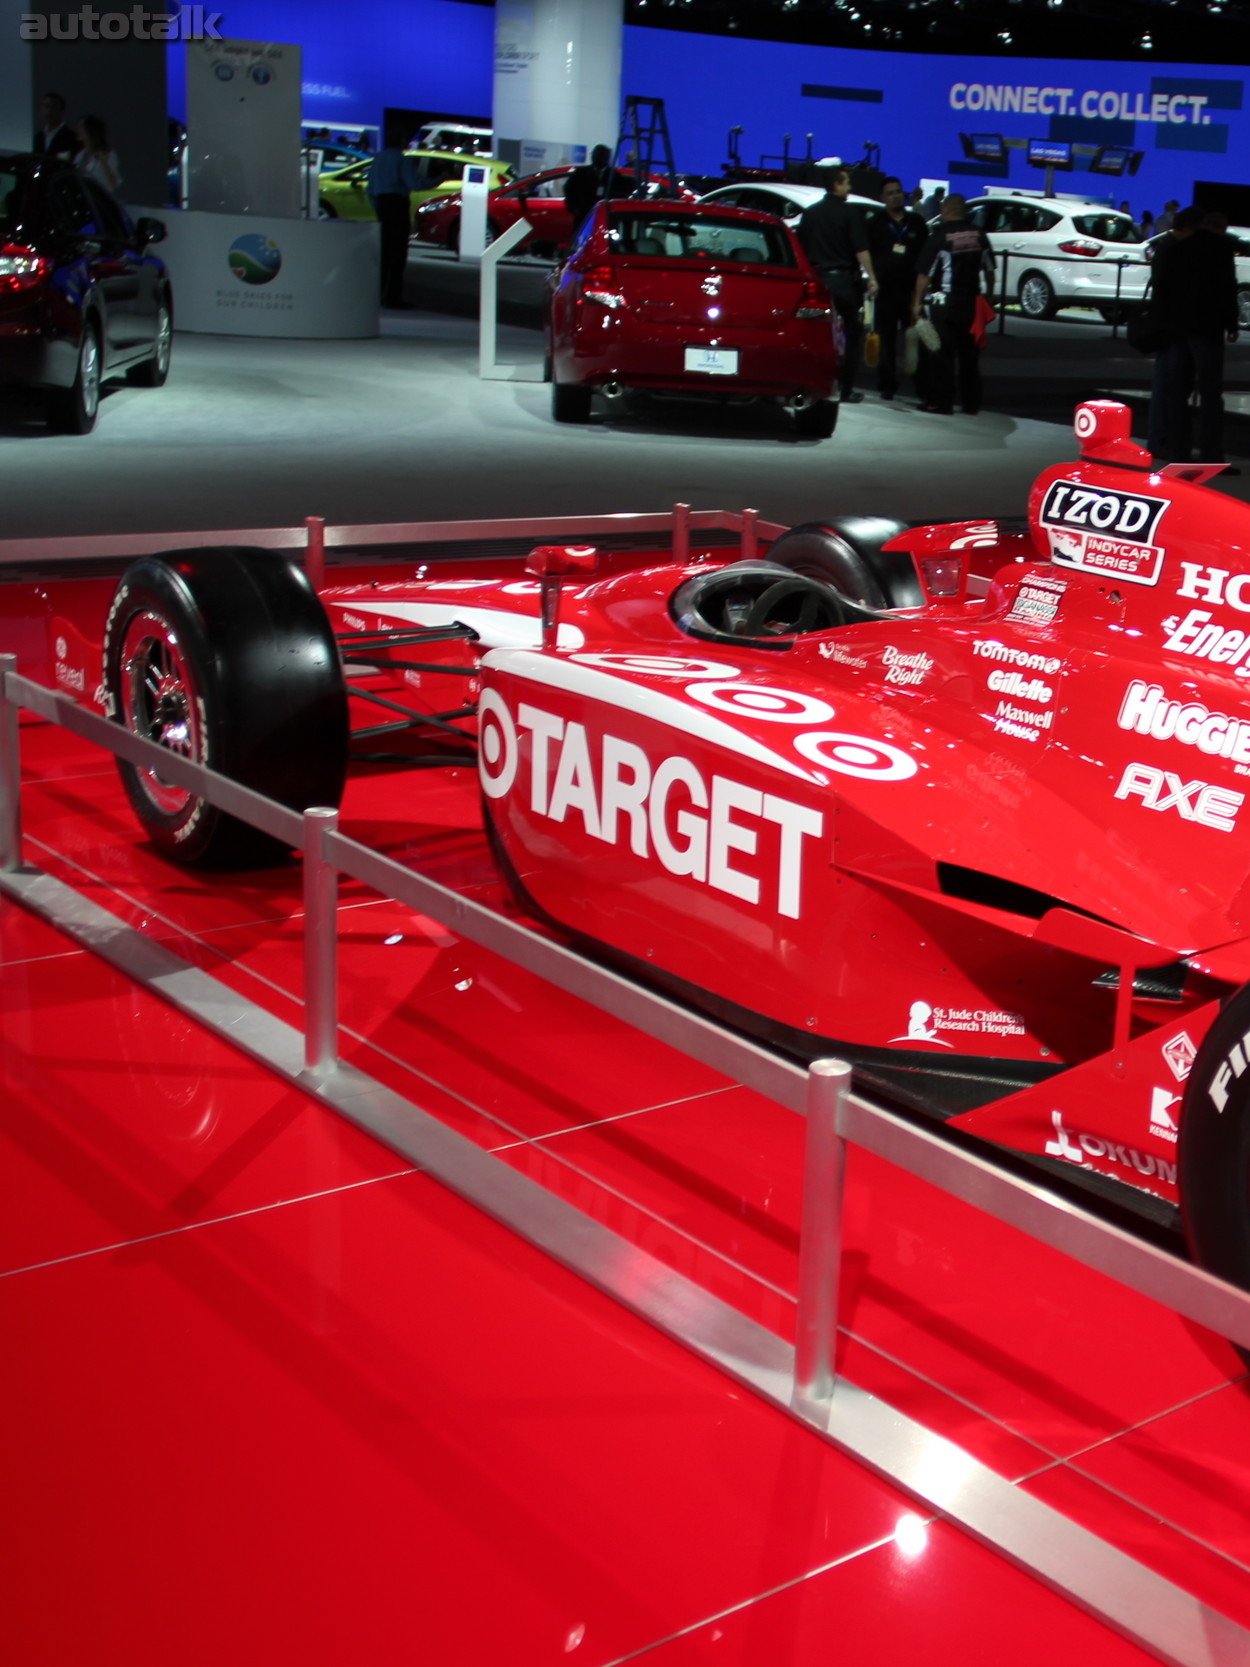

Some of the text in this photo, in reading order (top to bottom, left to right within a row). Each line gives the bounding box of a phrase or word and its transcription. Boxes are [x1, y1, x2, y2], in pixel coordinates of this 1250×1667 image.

[950, 83, 1210, 124] CONNECT. COLLECT.
[1047, 486, 1150, 533] IZOD
[1088, 539, 1151, 560] INDYCAR
[1085, 553, 1138, 572] SERIES
[881, 645, 934, 670] Breathe
[884, 665, 925, 686] Right
[987, 670, 1053, 703] Gillette
[995, 700, 1053, 729] Maxwell
[994, 718, 1040, 742] House
[1114, 762, 1245, 833] AXE
[517, 702, 823, 920] TARGET
[933, 1007, 946, 1019] St.
[948, 1009, 972, 1020] Jude
[934, 1019, 1025, 1036] Research Hospital
